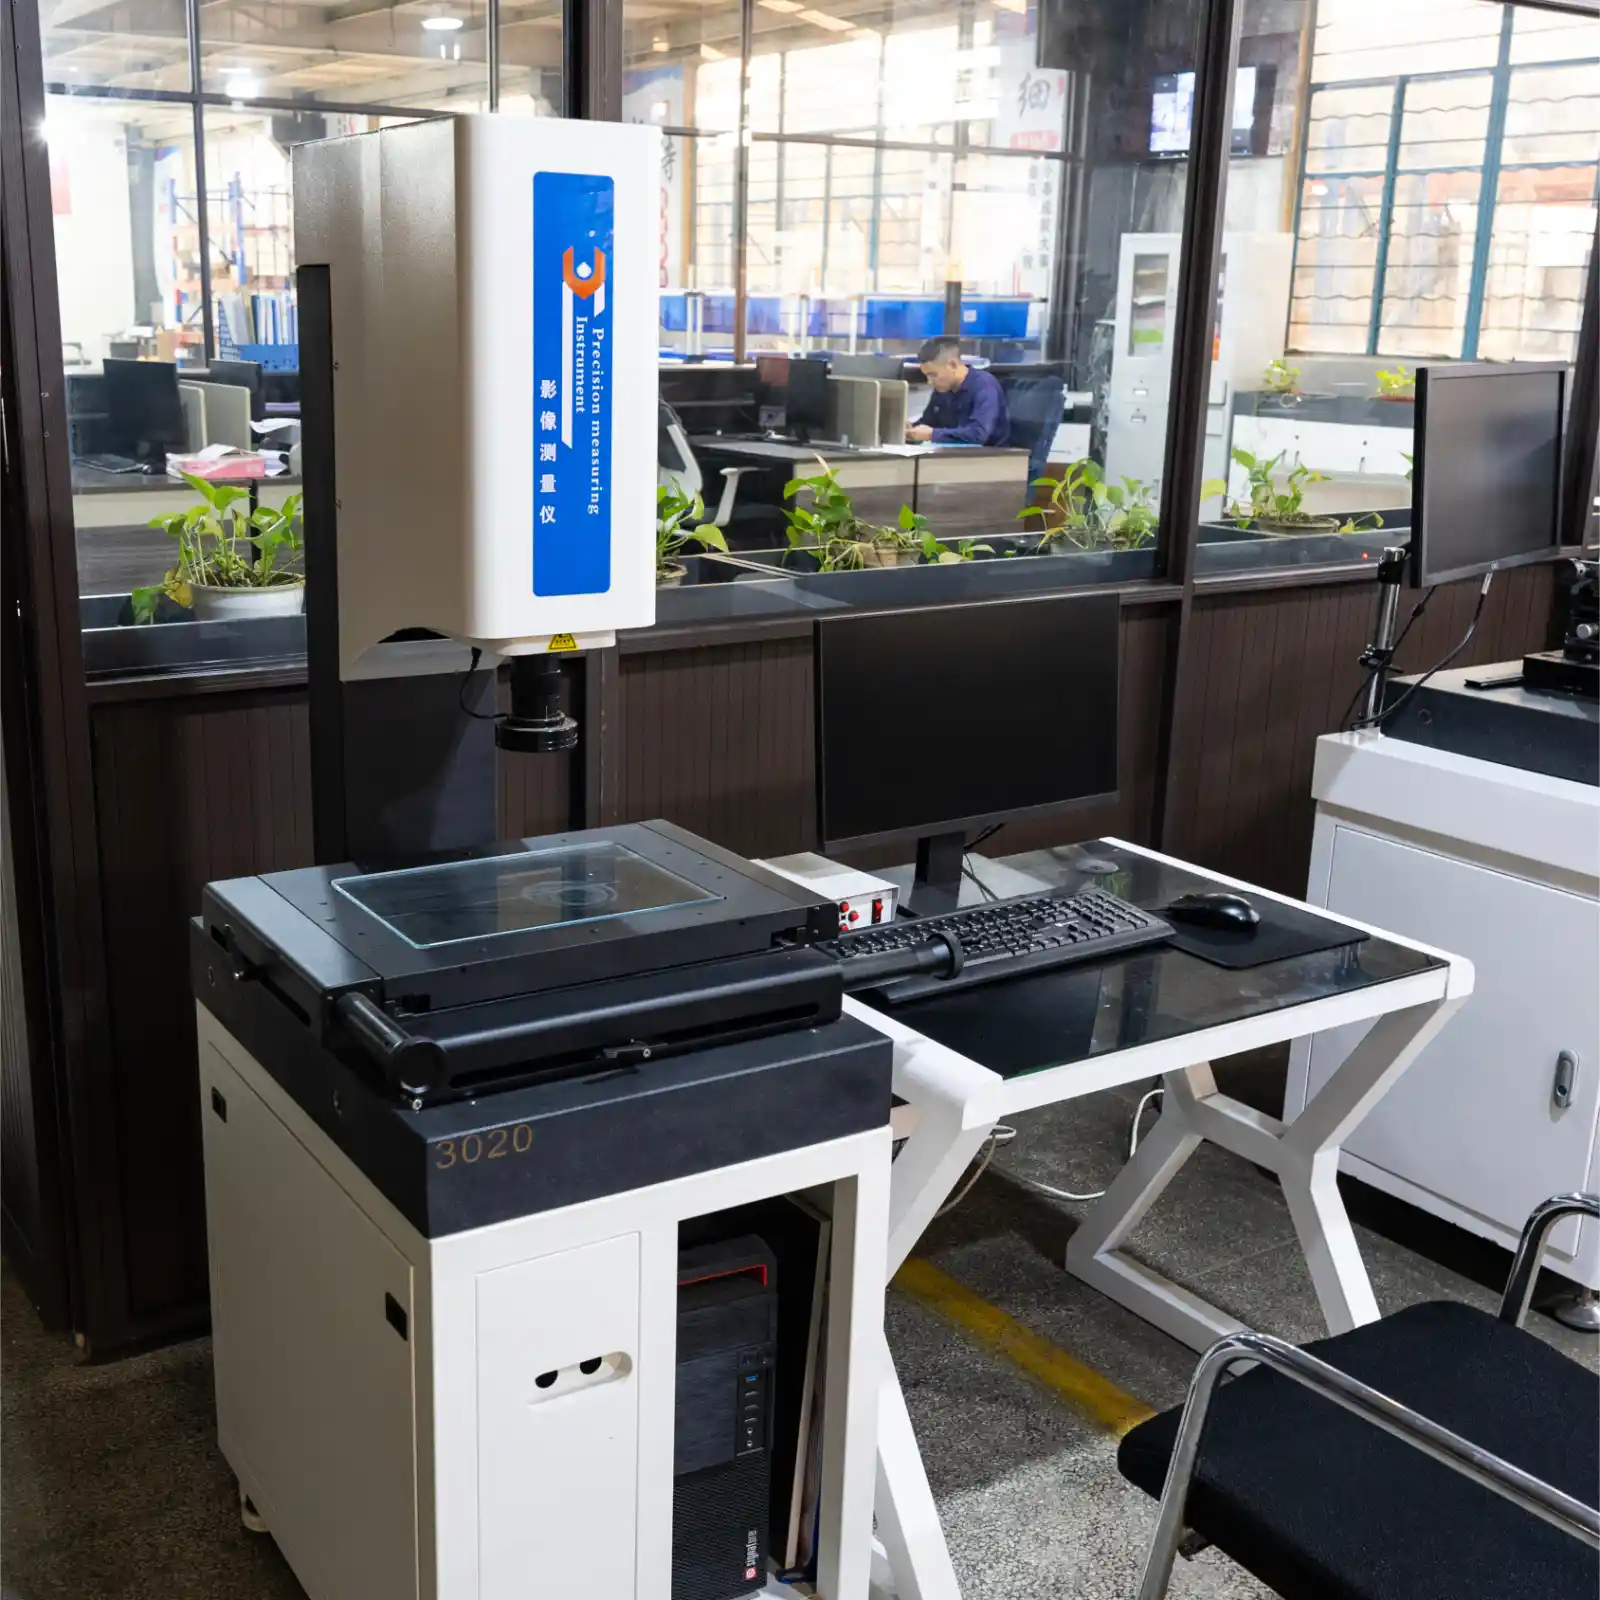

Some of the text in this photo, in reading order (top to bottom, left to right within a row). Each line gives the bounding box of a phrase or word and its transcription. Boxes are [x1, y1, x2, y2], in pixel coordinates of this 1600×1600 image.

[576, 316, 588, 413] Instrument
[587, 328, 605, 515] Precision measuring
[540, 379, 557, 524] 影像测量仪
[435, 1124, 532, 1169] 3020
